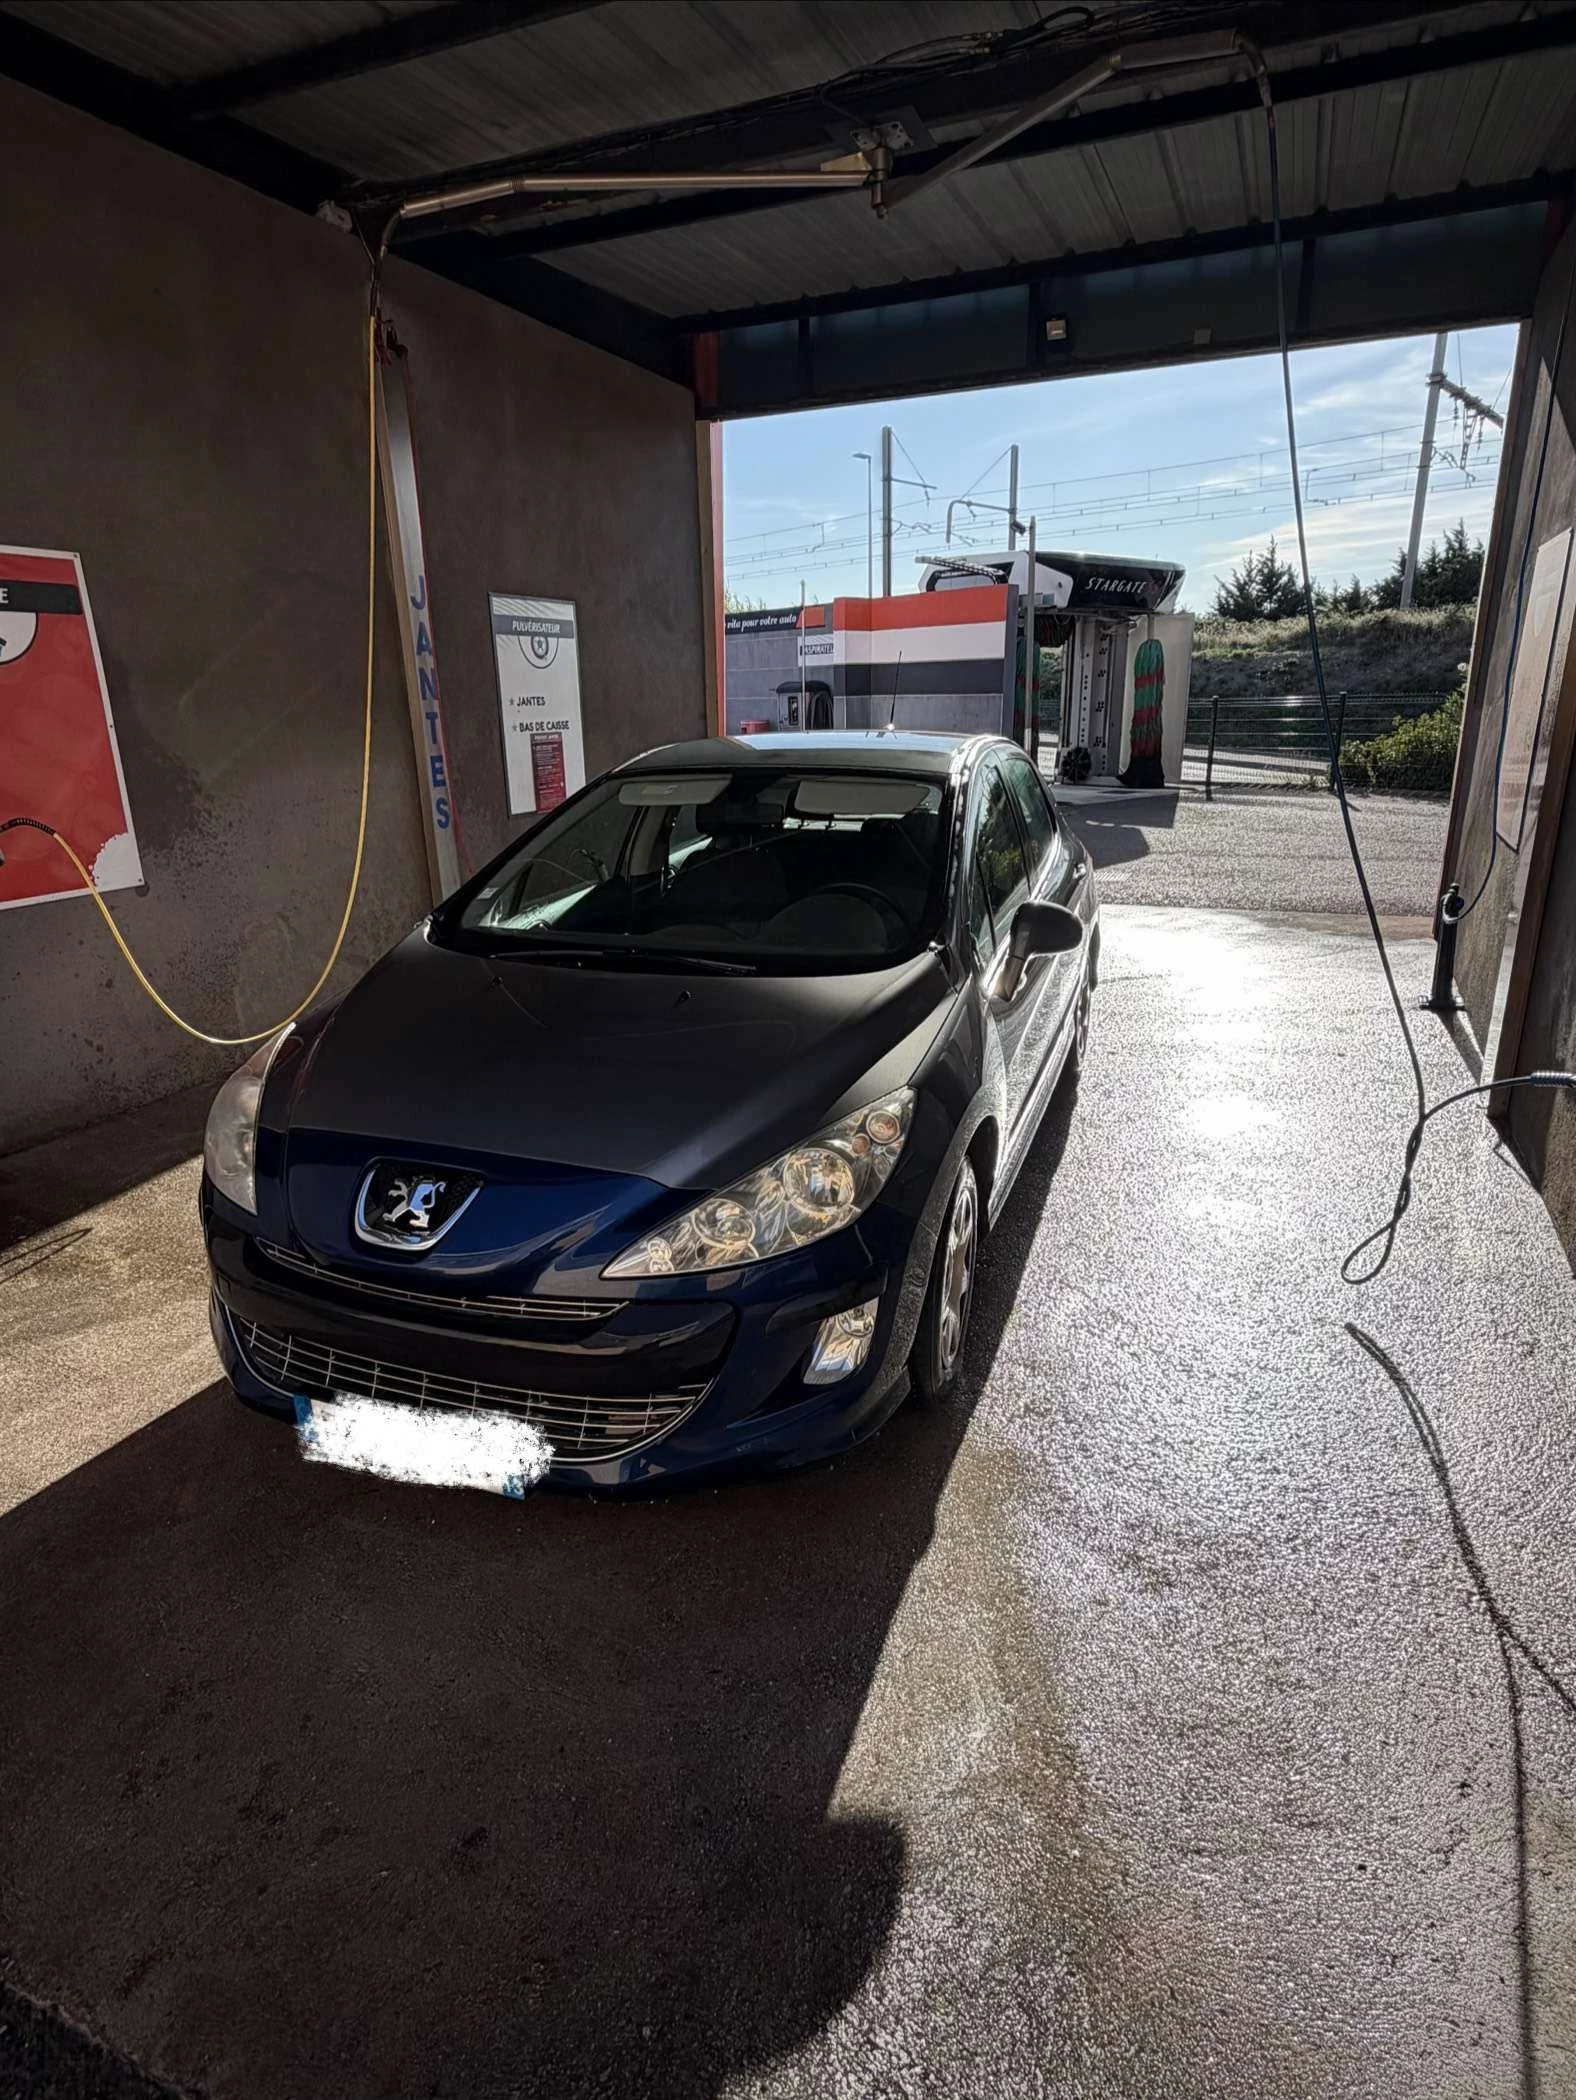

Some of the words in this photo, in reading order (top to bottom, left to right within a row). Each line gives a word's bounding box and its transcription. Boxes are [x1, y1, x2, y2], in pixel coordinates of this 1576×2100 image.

[1085, 577, 1146, 593] STARGATE
[741, 619, 759, 632] pour
[759, 616, 778, 626] votre
[779, 614, 797, 625] auto
[411, 575, 449, 829] JANTES
[517, 696, 546, 706] JANTES
[519, 722, 534, 732] BAS
[535, 721, 545, 731] DE
[546, 720, 570, 730] CAISSE
